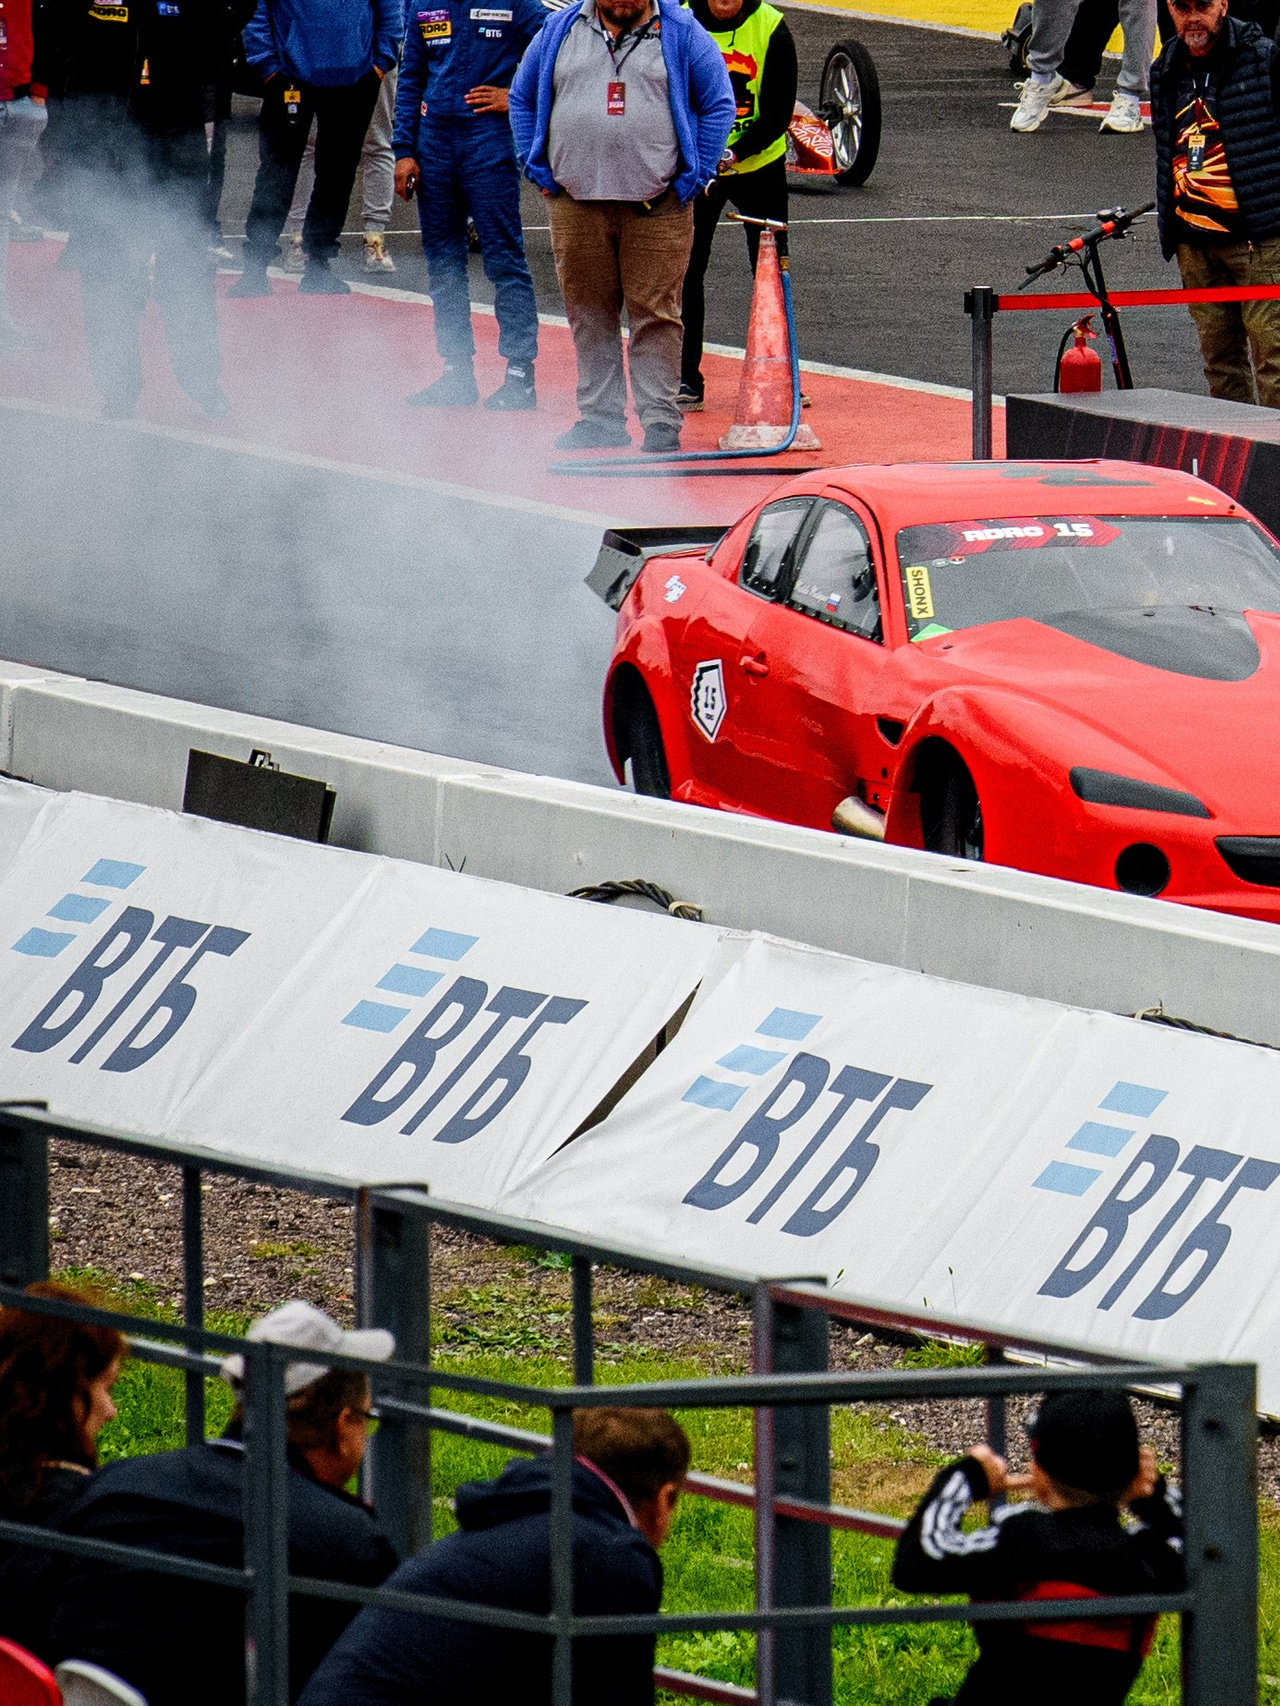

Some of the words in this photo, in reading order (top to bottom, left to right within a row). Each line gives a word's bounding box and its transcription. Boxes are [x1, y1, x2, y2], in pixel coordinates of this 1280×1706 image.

[485, 29, 502, 38] ВТБ
[962, 526, 1045, 542] RDRC
[1053, 523, 1094, 538] 15
[910, 569, 930, 616] SHONX
[10, 905, 252, 1074] ВТБ
[339, 975, 591, 1145] ВТБ
[681, 1051, 935, 1238] ВТБ
